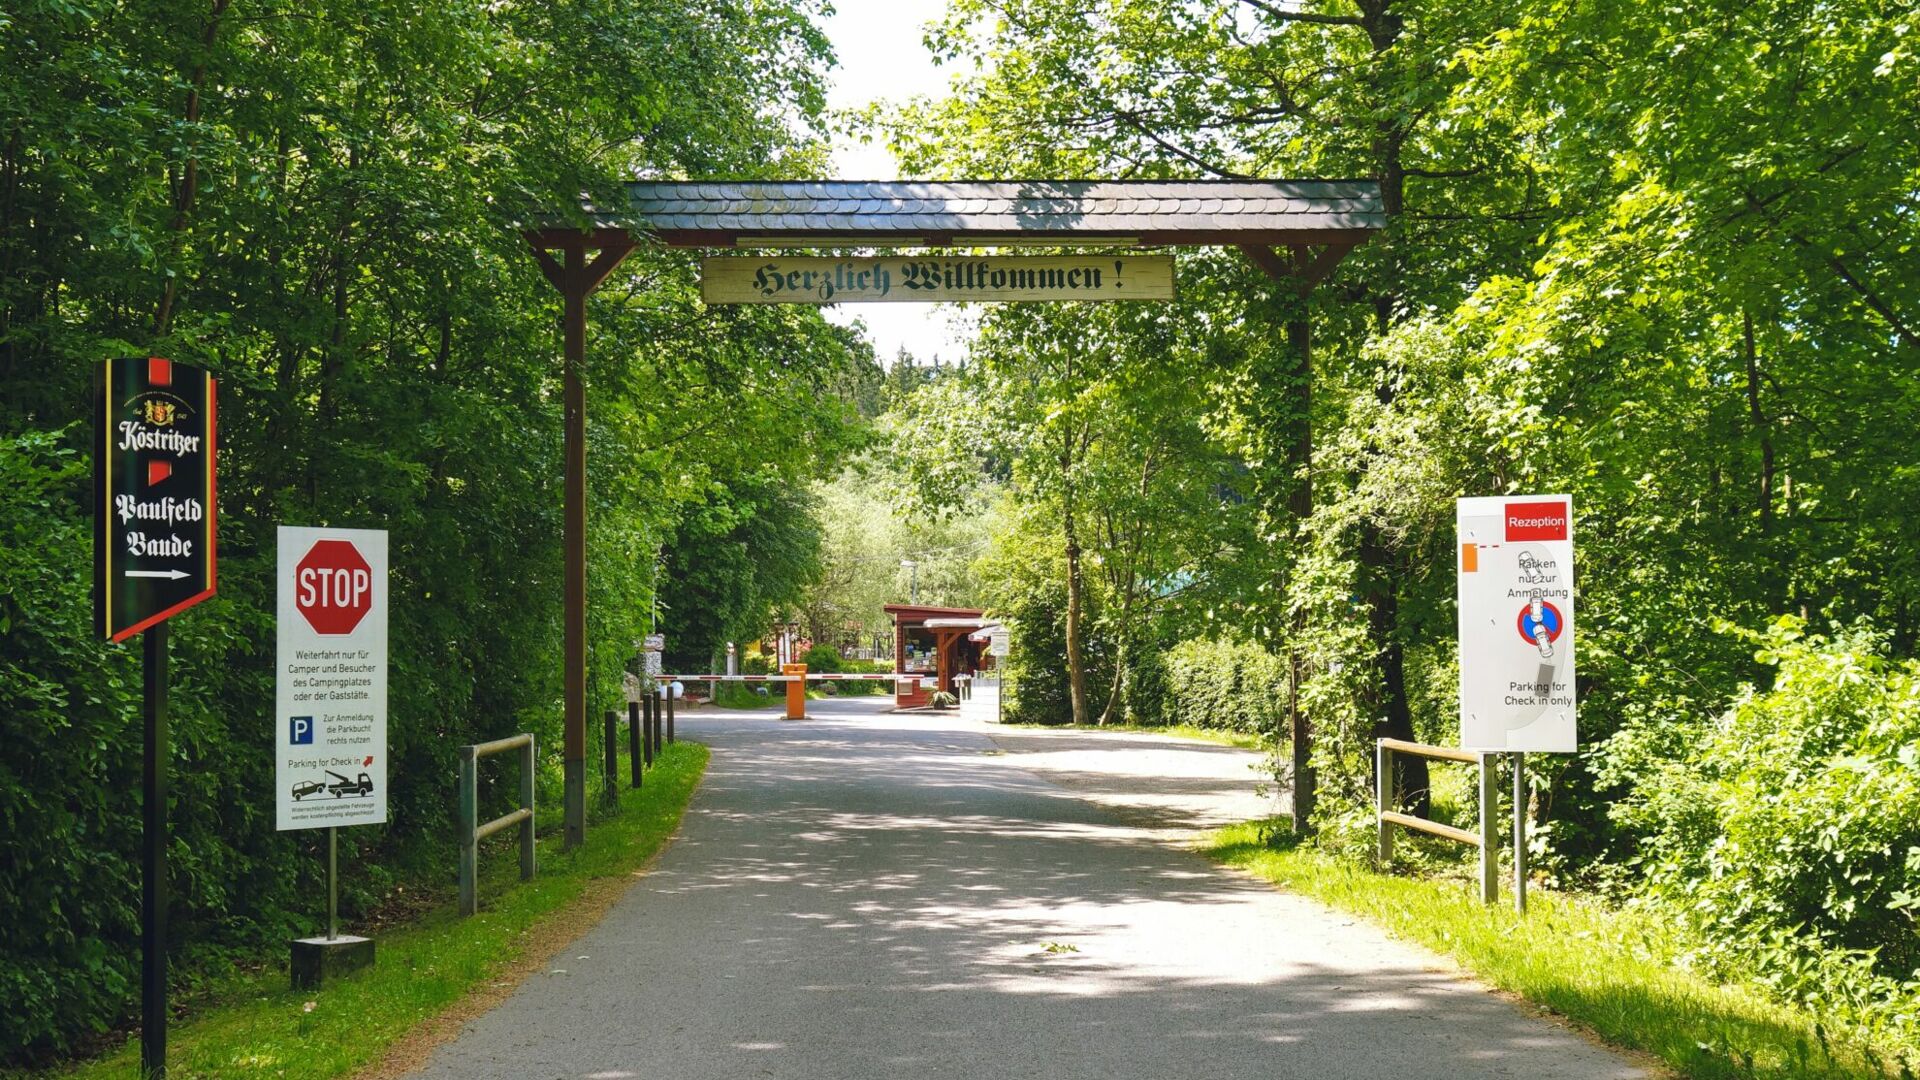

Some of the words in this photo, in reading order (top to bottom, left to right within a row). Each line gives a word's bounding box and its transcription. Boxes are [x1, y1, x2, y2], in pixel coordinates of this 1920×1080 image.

[753, 263, 890, 300] Herzlich
[902, 261, 1102, 290] Willkommen
[118, 420, 200, 457] Köstritzer
[115, 494, 202, 528] Paulfeld
[1509, 516, 1565, 528] Rezeption
[126, 531, 193, 558] Baude
[1518, 559, 1556, 569] Parken
[1518, 575, 1536, 583] nur
[1540, 574, 1557, 583] zur
[300, 567, 369, 608] STOP
[1507, 588, 1568, 599] Anmeldung
[295, 650, 340, 660] Weiterfahrt
[342, 652, 356, 660] nur
[358, 649, 370, 659] für
[288, 664, 320, 675] Camper
[322, 664, 337, 674] und
[339, 663, 376, 673] Besucher
[293, 678, 307, 688] des
[309, 677, 372, 689] Campingplatzes
[1510, 682, 1549, 693] Parking
[1552, 681, 1567, 691] for
[293, 691, 312, 701] oder
[314, 691, 328, 701] der
[1504, 695, 1535, 706] Check
[1538, 695, 1549, 706] in
[1551, 695, 1572, 708] only
[323, 714, 335, 723] Zur
[336, 714, 374, 723] Anmeldung
[295, 719, 308, 742] P
[327, 725, 336, 734] die
[338, 724, 372, 734] Parkbucht
[327, 737, 347, 745] rechts
[349, 736, 370, 744] nutzen
[288, 759, 317, 770] Parking
[319, 759, 329, 767] for
[331, 757, 352, 767] Check
[354, 756, 361, 765] in
